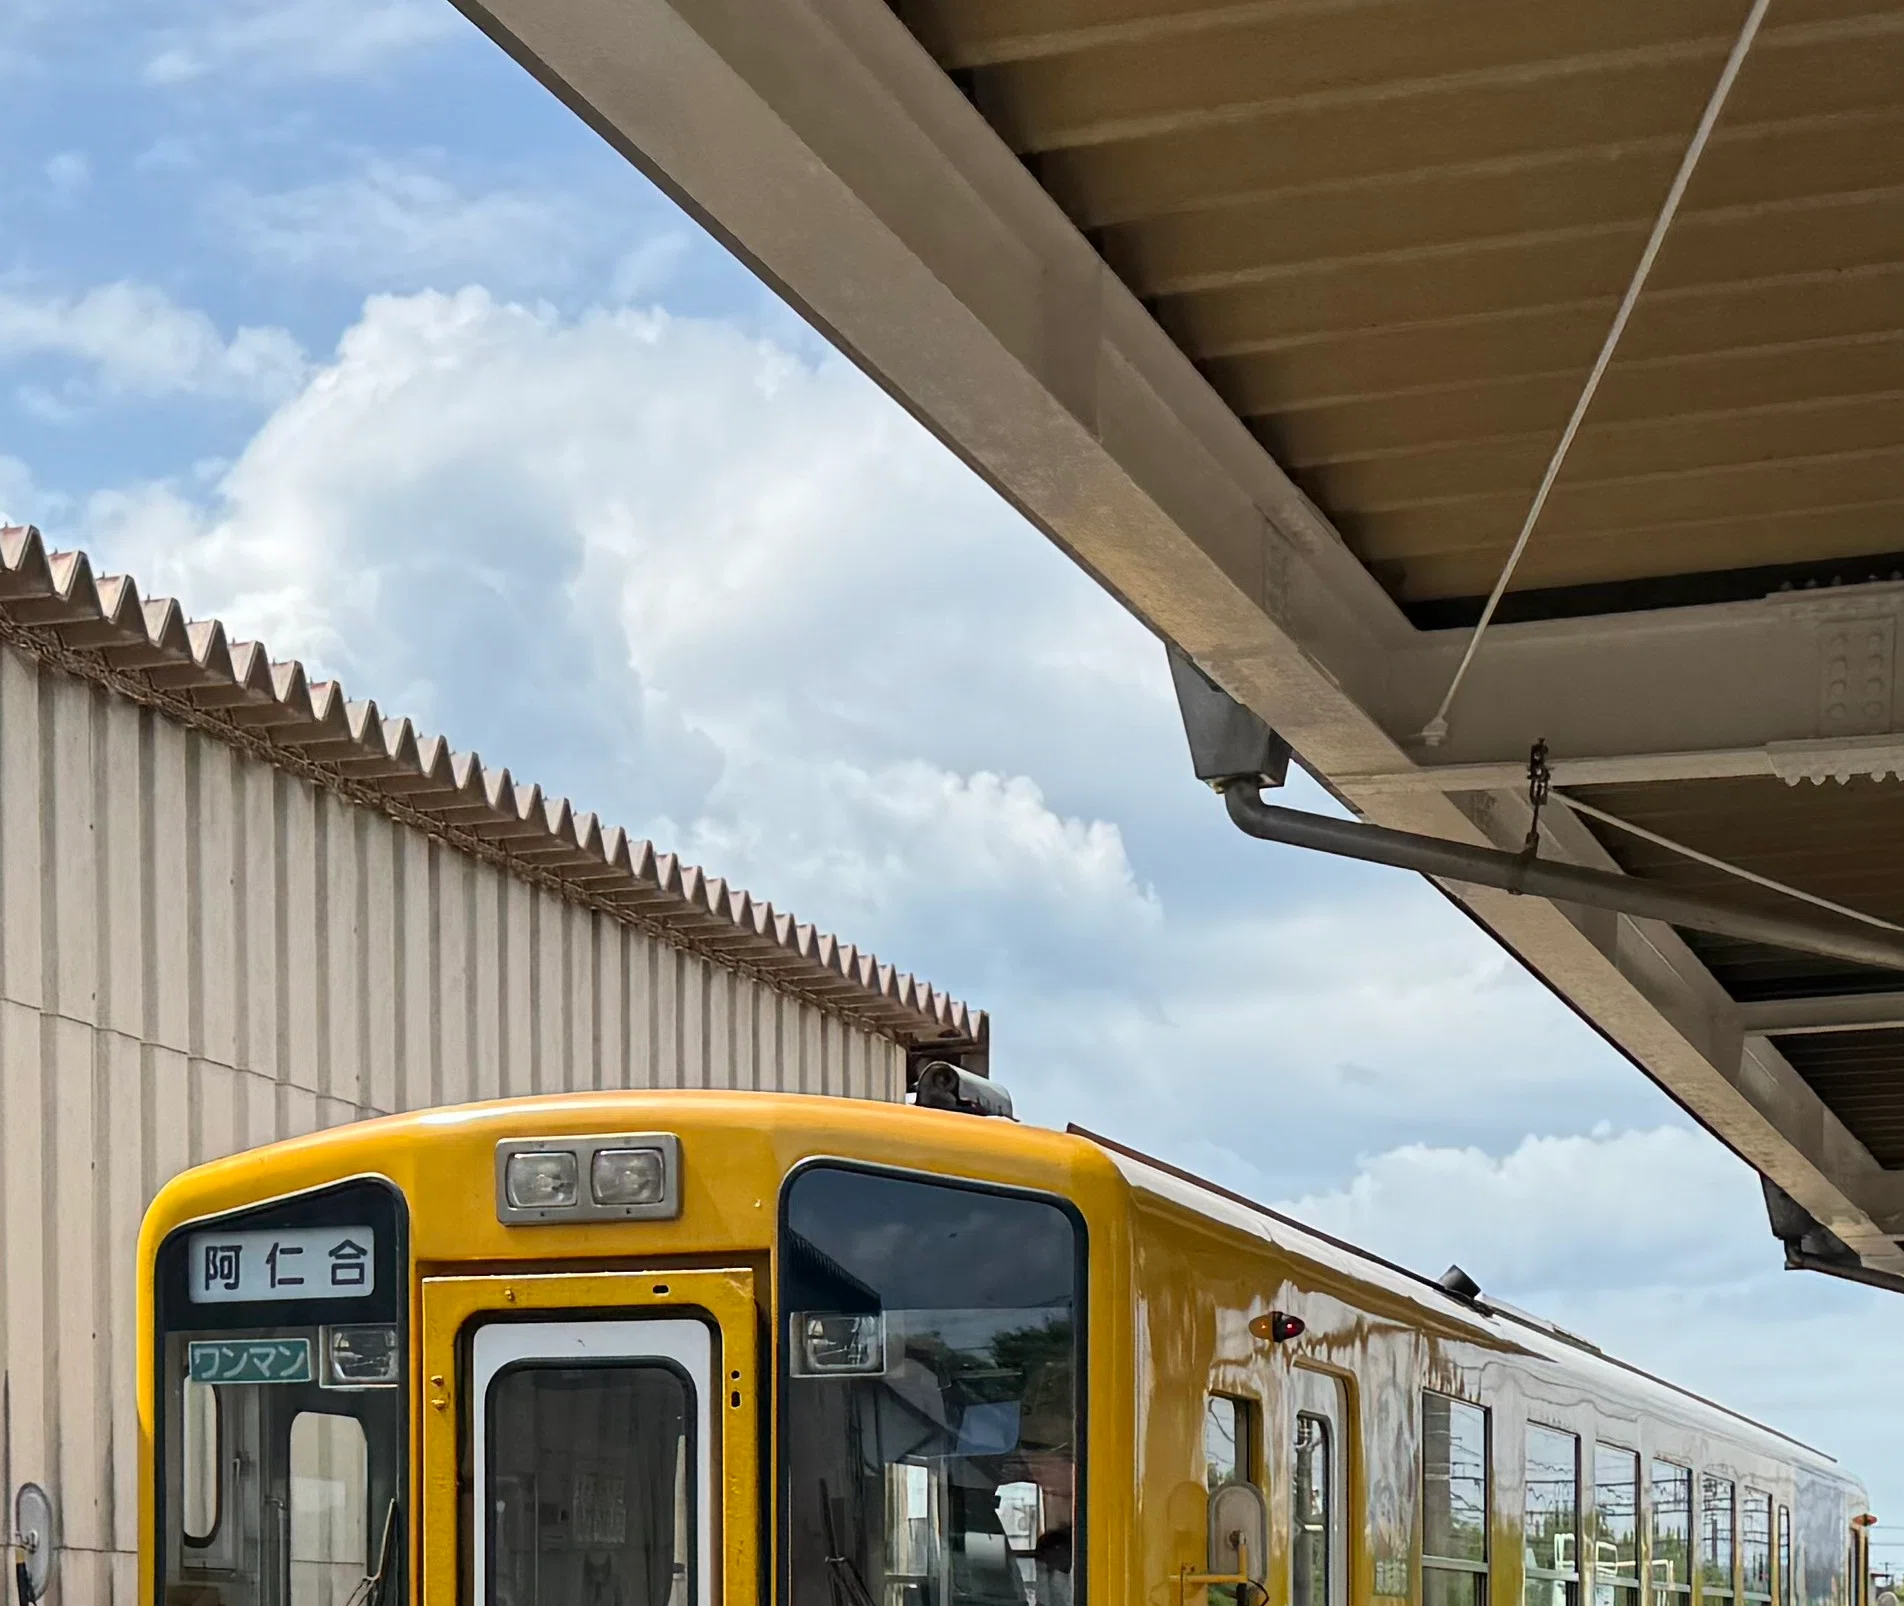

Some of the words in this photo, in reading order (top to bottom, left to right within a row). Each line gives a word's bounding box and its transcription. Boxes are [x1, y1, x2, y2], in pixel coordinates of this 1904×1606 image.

[204, 1239, 368, 1291] 阿仁合
[194, 1345, 305, 1378] ワンマン
